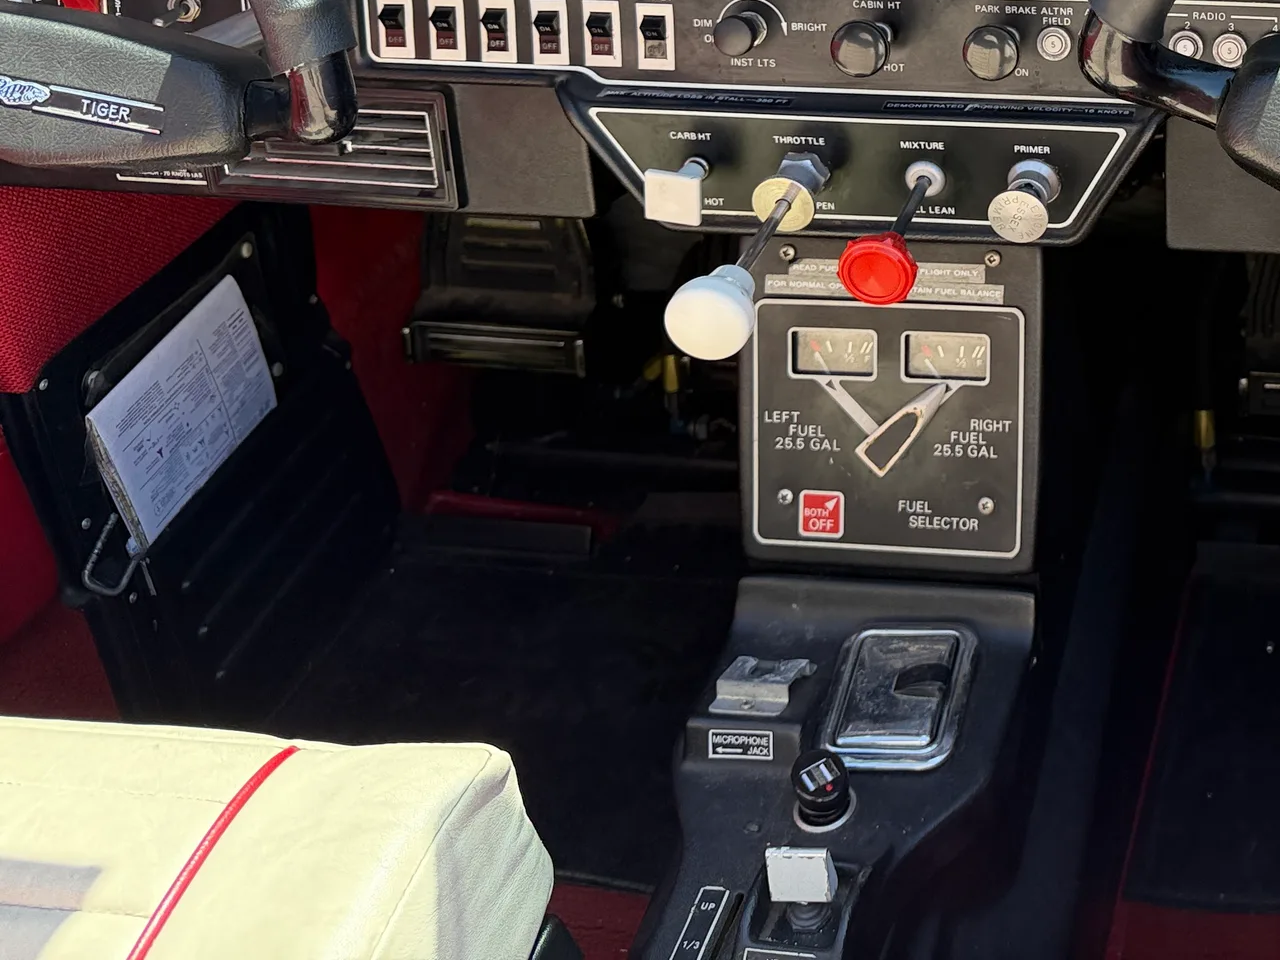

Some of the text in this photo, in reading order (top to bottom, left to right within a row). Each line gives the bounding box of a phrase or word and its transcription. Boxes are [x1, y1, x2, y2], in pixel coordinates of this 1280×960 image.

[853, 0, 901, 10] CABIN HT
[975, 4, 1037, 15] PARK BRAKE
[1041, 6, 1074, 16] ALTNR
[1192, 11, 1226, 22] RADIO
[693, 19, 712, 28] DIM
[1043, 16, 1071, 26] FIELD
[791, 22, 827, 33] BRIGHT
[731, 57, 776, 68] INST LTS
[884, 62, 904, 73] HOT
[1014, 67, 1029, 77] ON
[81, 99, 131, 121] TIGER
[773, 135, 825, 147] THROTTLE
[900, 140, 946, 151] MIXTURE
[1014, 145, 1051, 155] PRIMER
[704, 197, 725, 207] HOT
[929, 205, 956, 216] LEAN
[764, 410, 800, 423] LEFT
[789, 424, 825, 437] FUEL
[970, 419, 1012, 432] RIGHT
[951, 431, 987, 444] FUEL
[775, 437, 841, 451] 25.5 GAL
[933, 444, 998, 459] 25.5 GAL
[804, 507, 830, 517] BOTH
[898, 500, 932, 513] FUEL
[809, 518, 835, 530] OFF
[908, 516, 979, 531] SELECTOR
[713, 735, 769, 746] MICROPHONE
[747, 746, 769, 755] JACK
[700, 902, 716, 911] UP
[682, 940, 700, 951] 1/3
